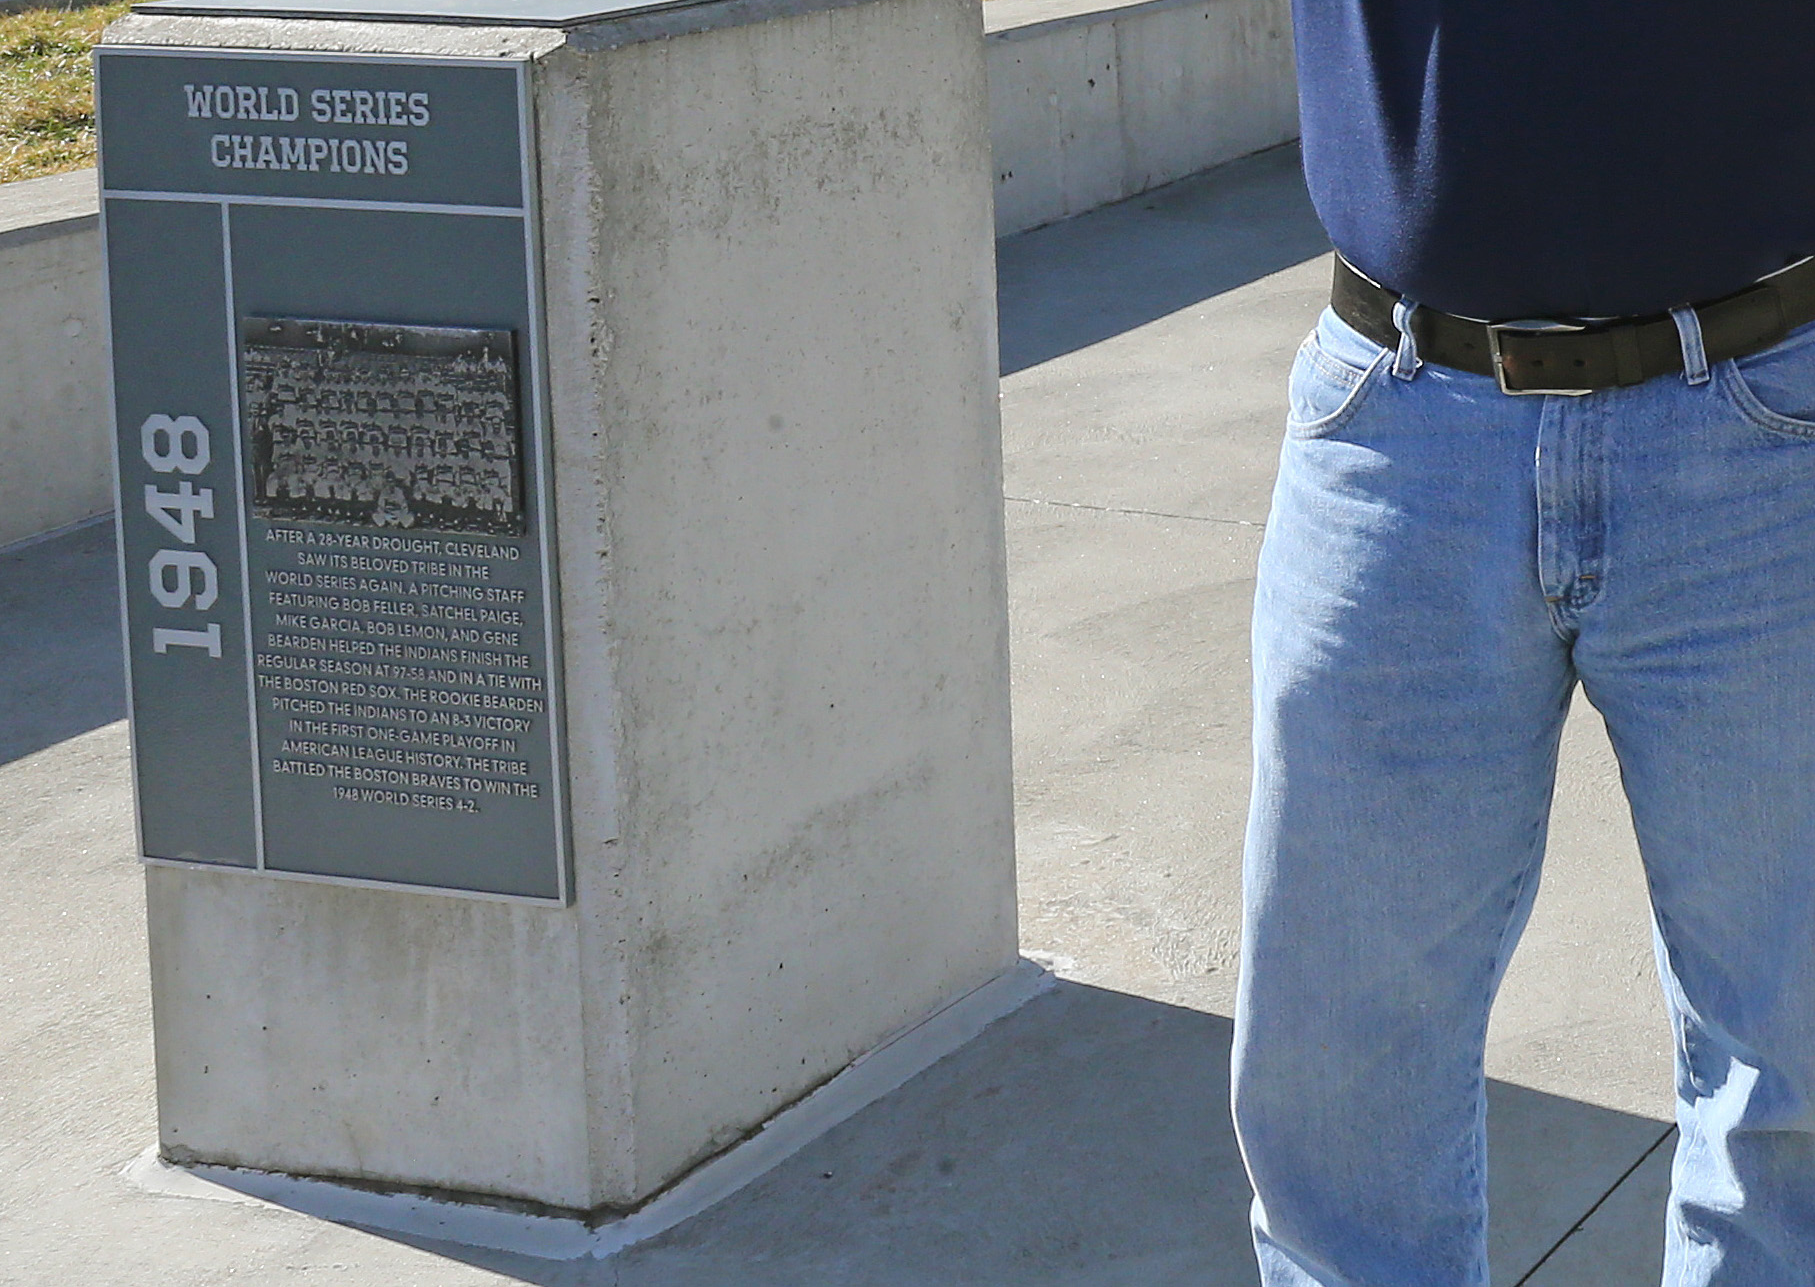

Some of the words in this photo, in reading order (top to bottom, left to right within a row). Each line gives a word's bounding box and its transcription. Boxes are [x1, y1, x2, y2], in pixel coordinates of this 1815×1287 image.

[183, 84, 299, 122] WORLD
[311, 89, 430, 126] SERIES
[210, 134, 409, 175] CHAMPIONS
[140, 413, 222, 658] 1948
[265, 528, 304, 544] AFTER
[305, 531, 316, 545] A
[318, 532, 370, 549] 28-YEAR
[371, 536, 442, 556] DROUGHT,
[444, 541, 519, 560] CLEVELAND
[297, 551, 327, 566] SAW
[329, 554, 348, 569] ITS
[350, 555, 409, 573] BELOVED
[410, 560, 446, 576] TRIBE
[447, 562, 462, 577] IN
[463, 564, 489, 580] THE
[264, 570, 313, 587] WORLD
[315, 574, 356, 590] SERIES
[358, 578, 406, 594] AGAIN.
[407, 581, 418, 595] A
[420, 582, 483, 601] PITCHING
[486, 587, 524, 605] STAFF
[268, 591, 339, 610] FEATURING
[341, 597, 370, 613] BOB
[372, 599, 418, 618] FELLER,
[420, 604, 477, 622] SATCHEL
[479, 608, 523, 627] PAIGE,
[275, 613, 306, 629] MIKE
[308, 615, 364, 634] GARCIA,
[366, 620, 395, 636] BOB
[397, 623, 448, 642] LEMON,
[449, 627, 480, 643] AND
[482, 630, 518, 648] GENE
[267, 633, 326, 651] BEARDEN
[328, 638, 376, 658] HELPED
[377, 642, 401, 660] THE
[403, 645, 458, 663] INDIANS
[460, 649, 502, 669] FINISH
[503, 653, 528, 671] THE
